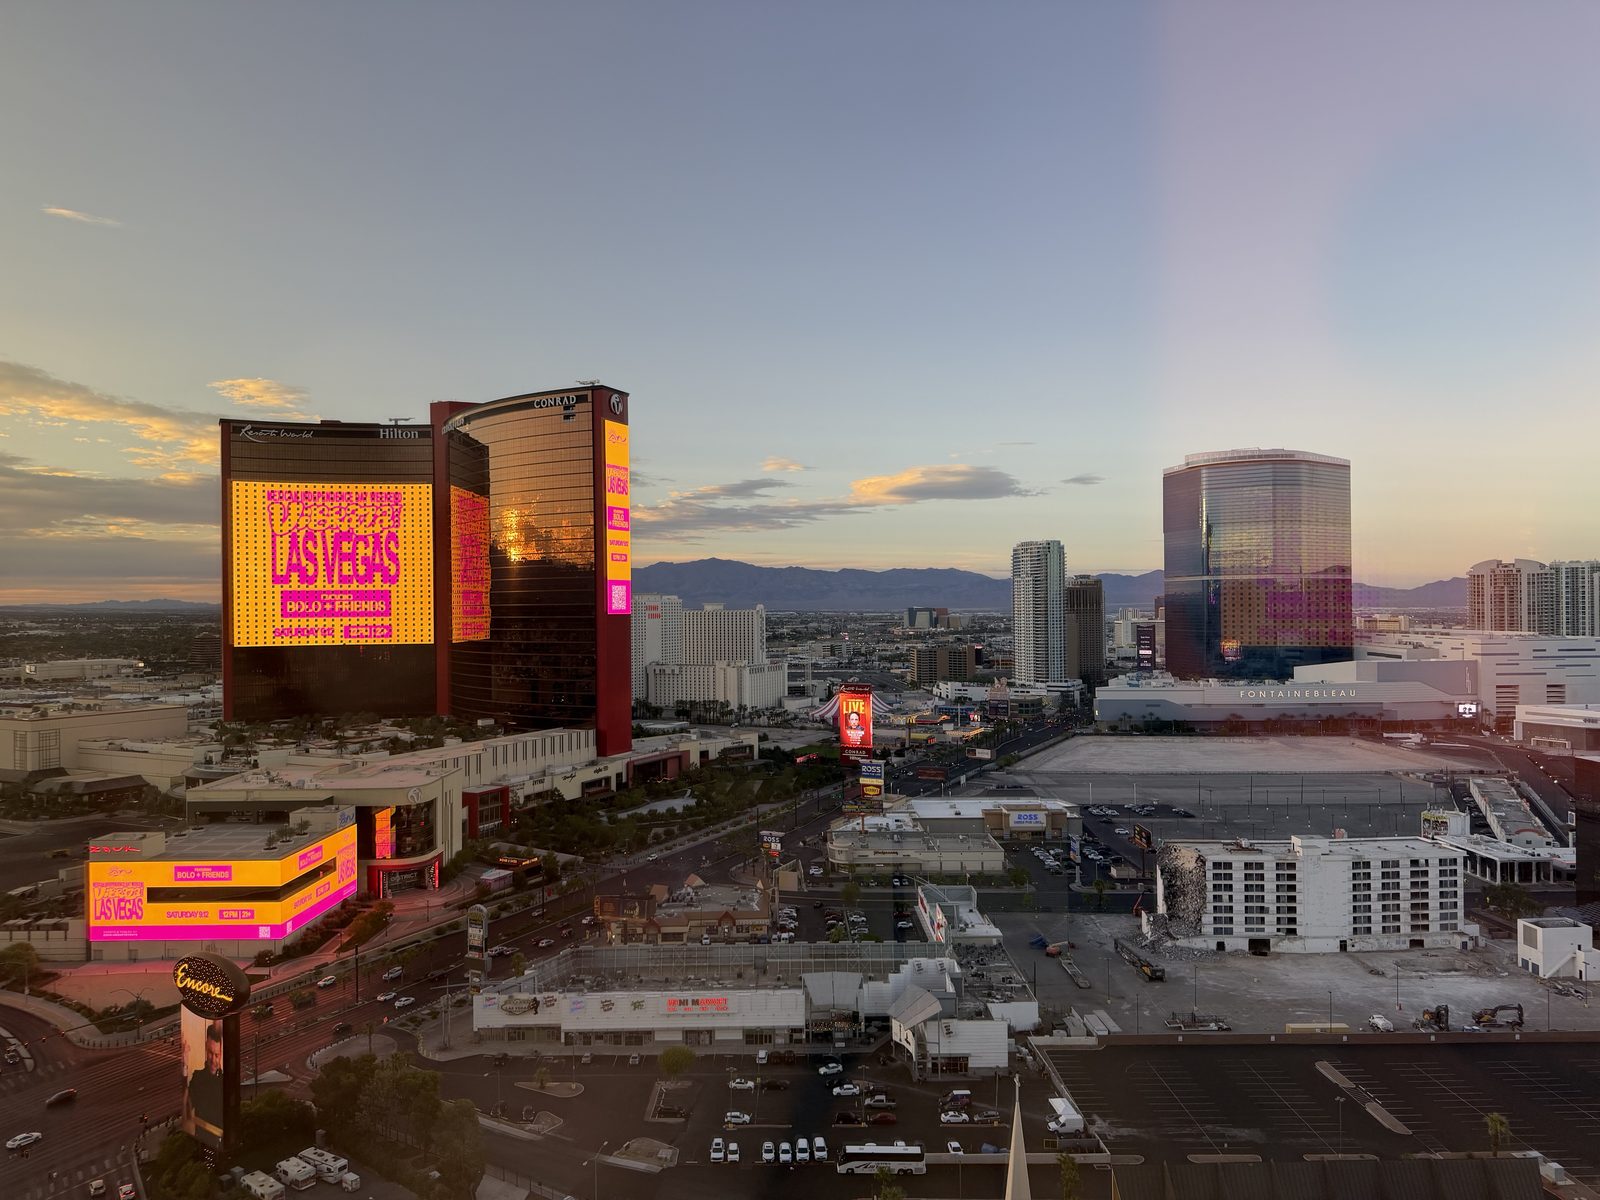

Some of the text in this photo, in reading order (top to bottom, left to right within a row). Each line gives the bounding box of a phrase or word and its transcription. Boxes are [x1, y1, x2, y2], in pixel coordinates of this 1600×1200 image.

[534, 395, 577, 409] CONRAD
[379, 427, 419, 440] Hilton
[271, 529, 401, 586] LAS VEGAS
[286, 600, 322, 613] BOLO
[335, 600, 387, 613] FRIENDS
[1239, 689, 1357, 699] FONTAINEBLEAU
[843, 700, 865, 714] LIVE
[861, 765, 881, 773] ROSS
[176, 871, 196, 879] BOLO
[201, 871, 230, 879] FRIENDS
[94, 897, 144, 921] LAS VEGAS
[166, 910, 198, 919] SATURDAY
[176, 963, 233, 1002] Encore
